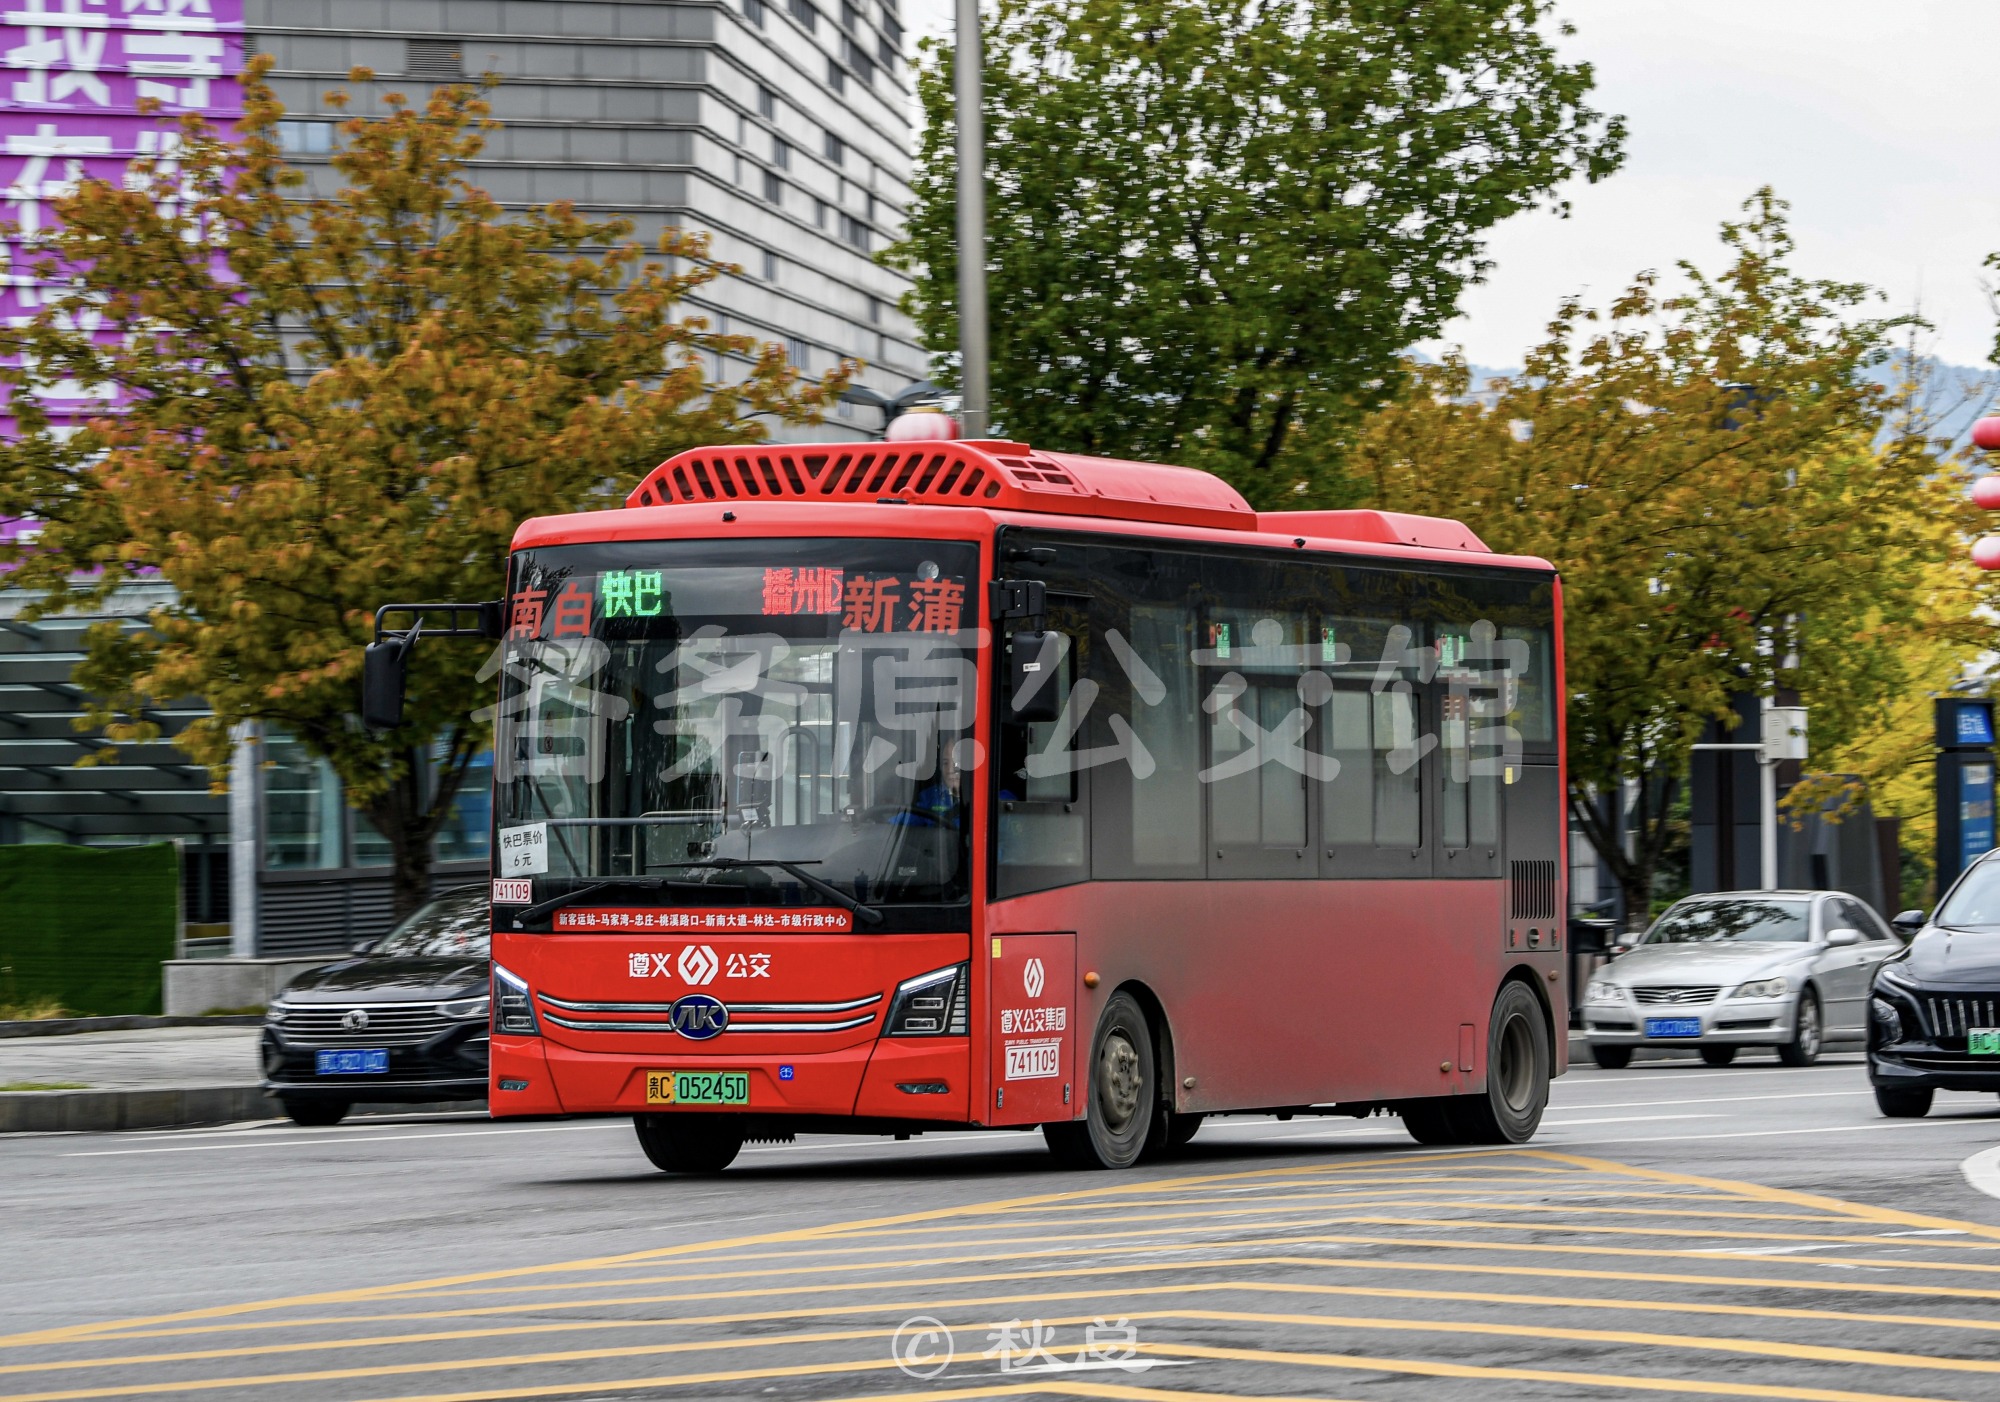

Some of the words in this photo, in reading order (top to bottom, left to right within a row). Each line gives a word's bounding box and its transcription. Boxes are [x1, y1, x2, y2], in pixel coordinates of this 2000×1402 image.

[602, 571, 663, 618] 快巴
[841, 575, 965, 636] 新蒲
[509, 584, 593, 642] 南白
[503, 830, 542, 849] 快巴票价
[495, 882, 529, 900] 741109
[628, 952, 671, 978] 遵义
[725, 952, 771, 978] 公交
[1001, 1007, 1066, 1034] 遵义公交集团
[1010, 1049, 1056, 1074] 741109
